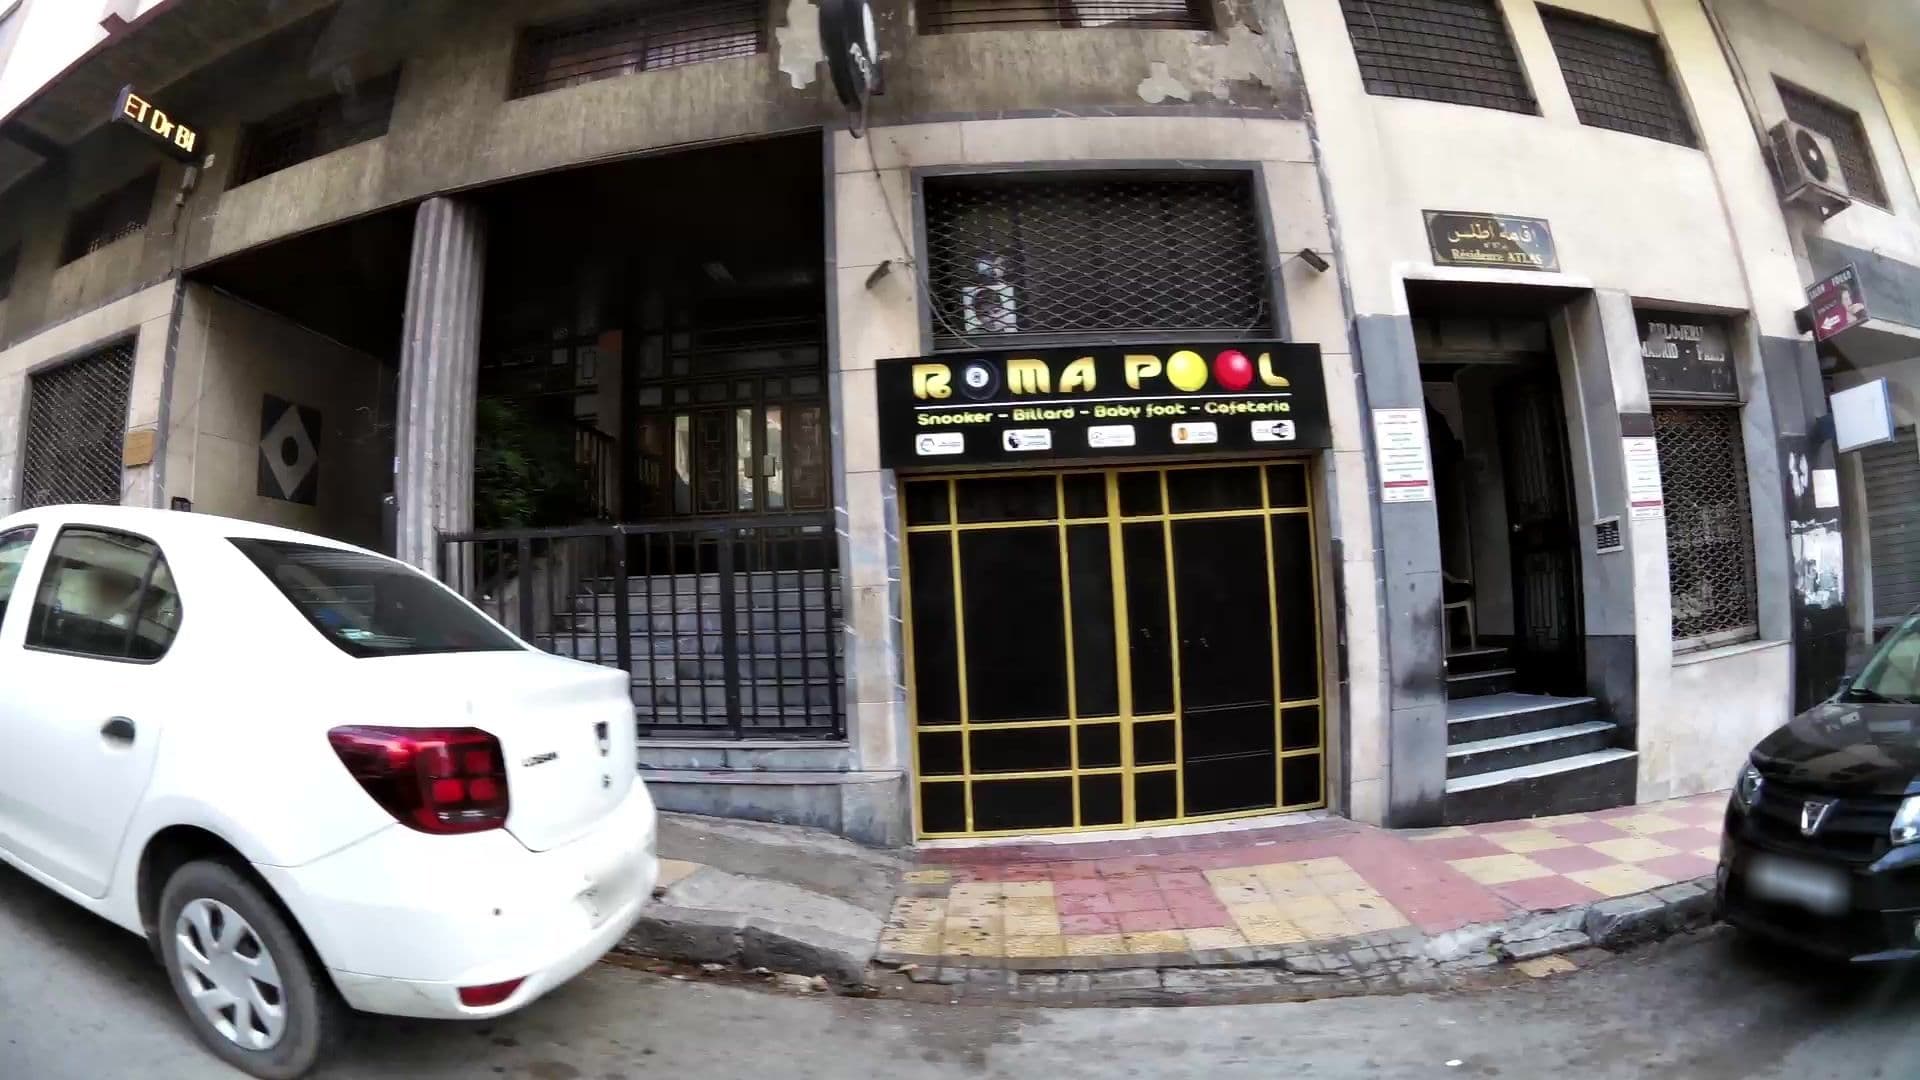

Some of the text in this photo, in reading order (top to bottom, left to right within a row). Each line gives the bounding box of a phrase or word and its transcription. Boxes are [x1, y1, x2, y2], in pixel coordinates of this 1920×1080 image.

[1507, 252, 1543, 265] ATLAS
[912, 349, 1290, 400] ROMA POOL
[917, 411, 994, 426] Snooker
[1012, 406, 1075, 421] Billard
[1094, 405, 1141, 419] Baby
[1145, 402, 1187, 418] foot
[1204, 400, 1291, 415] Cafeteria
